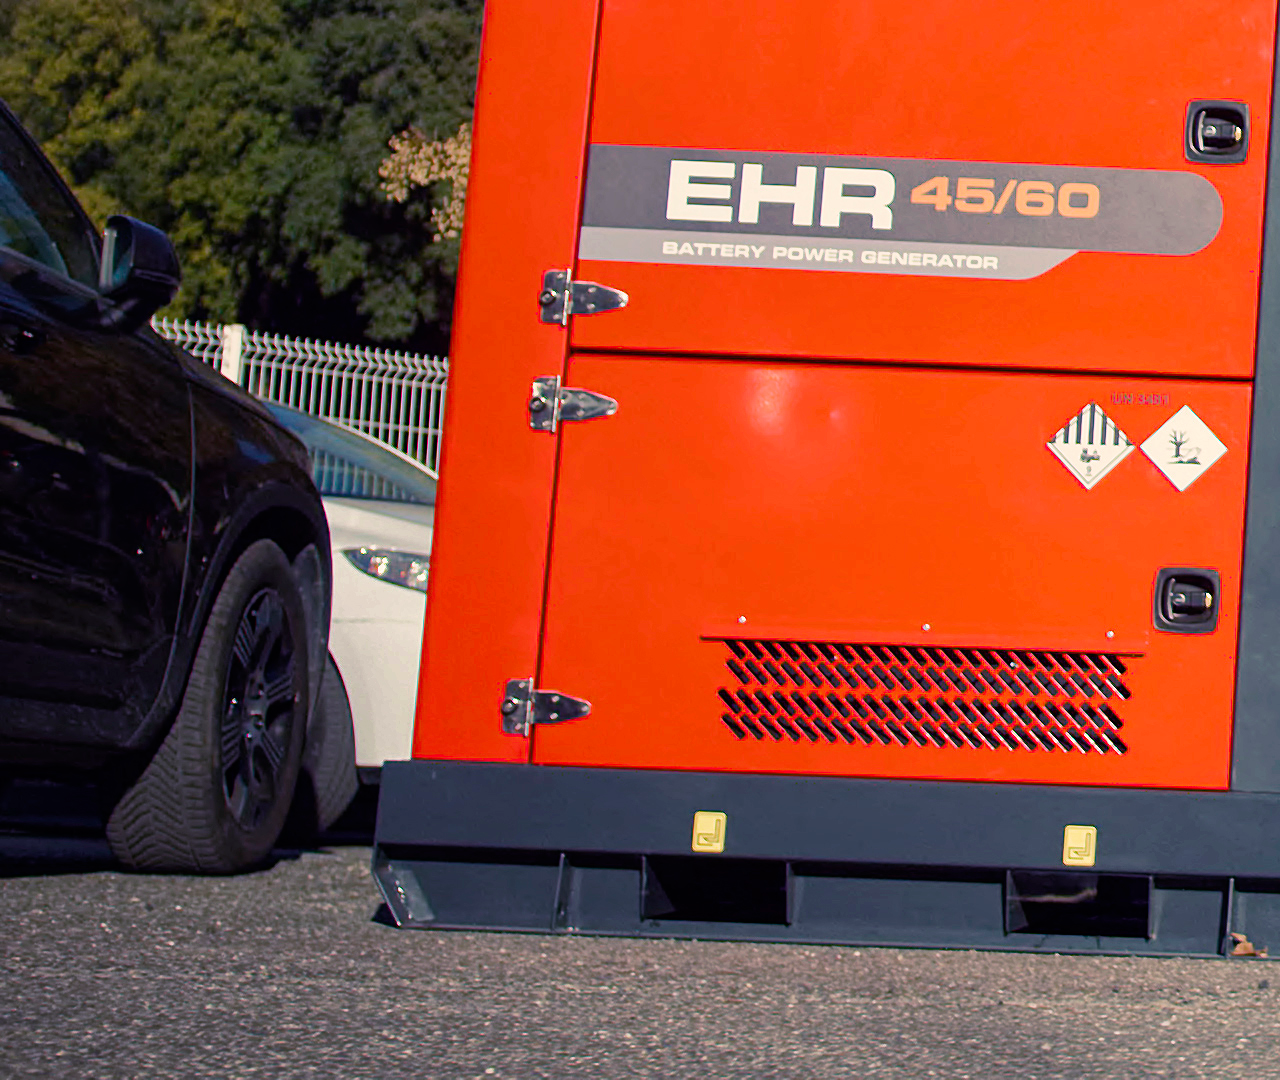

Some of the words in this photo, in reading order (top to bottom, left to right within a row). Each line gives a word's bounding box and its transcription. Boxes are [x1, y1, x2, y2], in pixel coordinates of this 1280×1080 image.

[666, 158, 896, 230] EHR
[910, 175, 1100, 219] 45/60
[662, 240, 765, 259] BATTERY
[772, 246, 854, 263] POWER
[861, 250, 999, 270] GENERATOR
